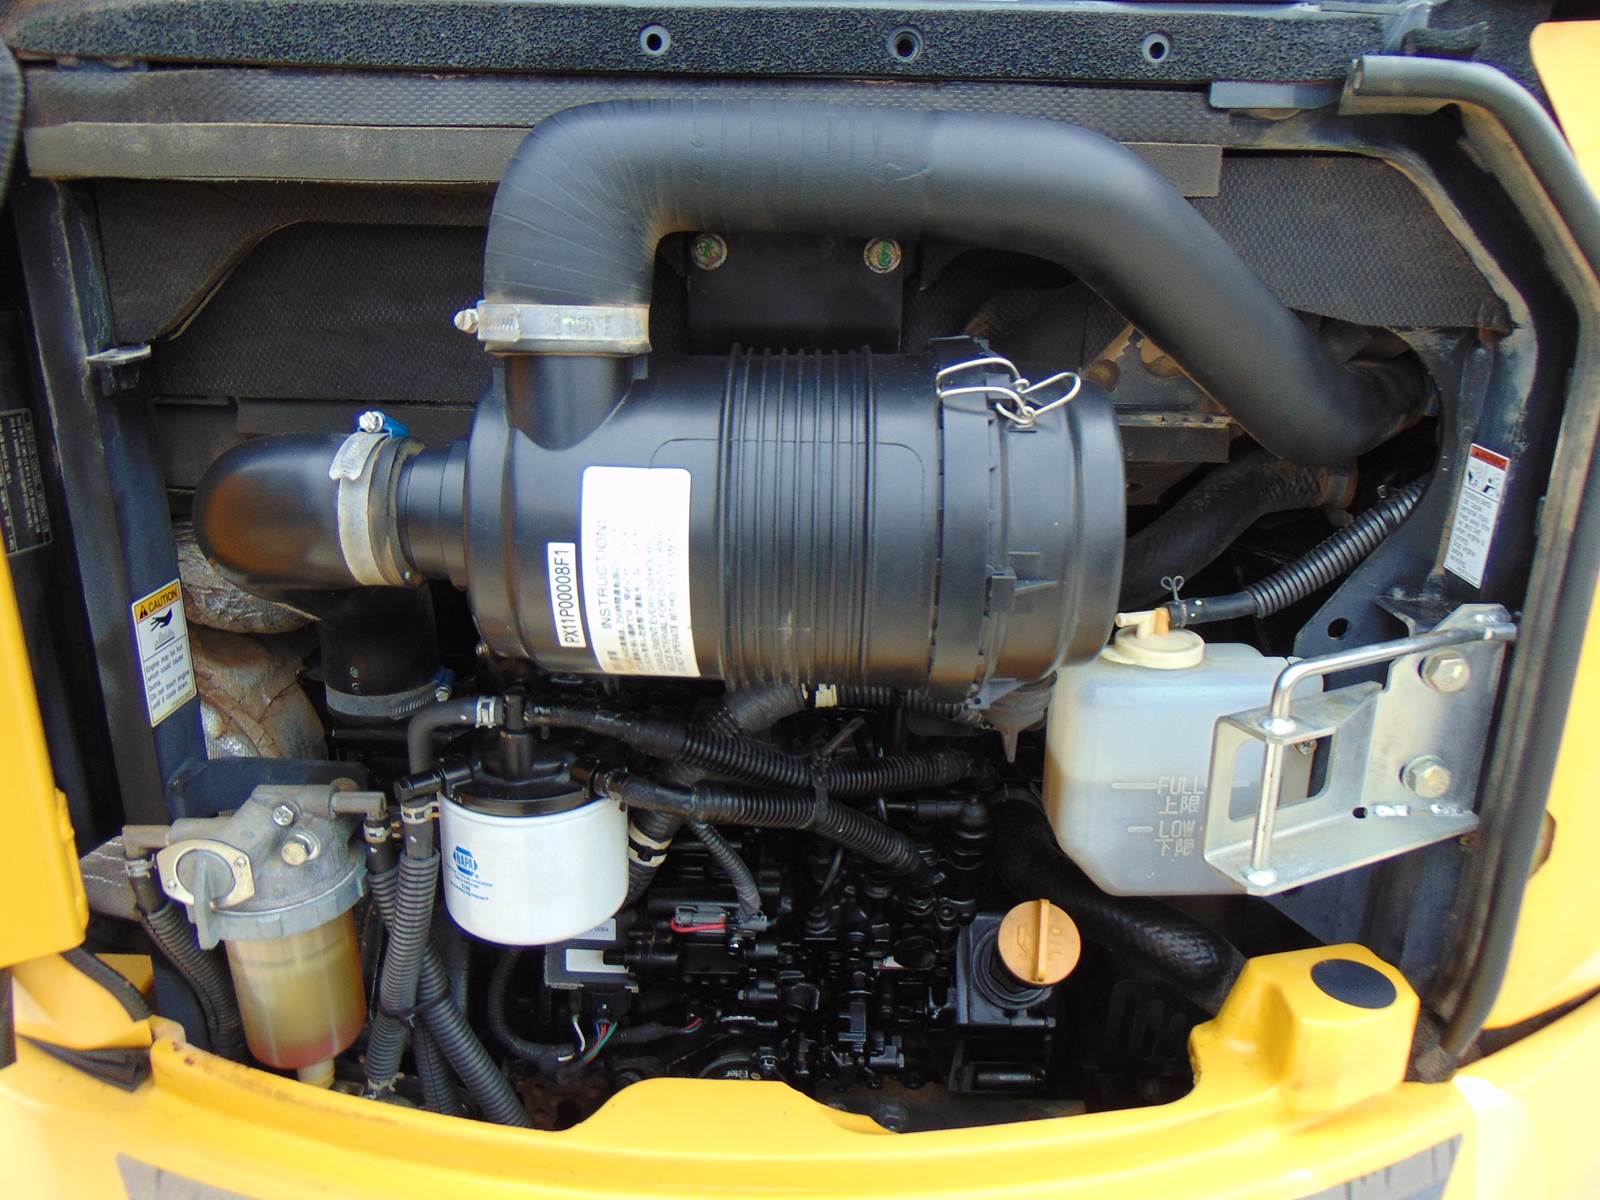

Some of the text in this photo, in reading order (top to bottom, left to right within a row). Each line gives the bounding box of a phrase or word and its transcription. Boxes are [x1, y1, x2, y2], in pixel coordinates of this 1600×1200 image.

[148, 588, 178, 614] CAUTION
[554, 549, 579, 643] PX11P00008F1
[1157, 775, 1204, 795] FULL
[1157, 795, 1201, 815] 上限
[1158, 819, 1197, 839] LOW
[1154, 838, 1195, 857] 下限
[455, 850, 474, 870] NAPA
[1048, 927, 1064, 961] OIL
